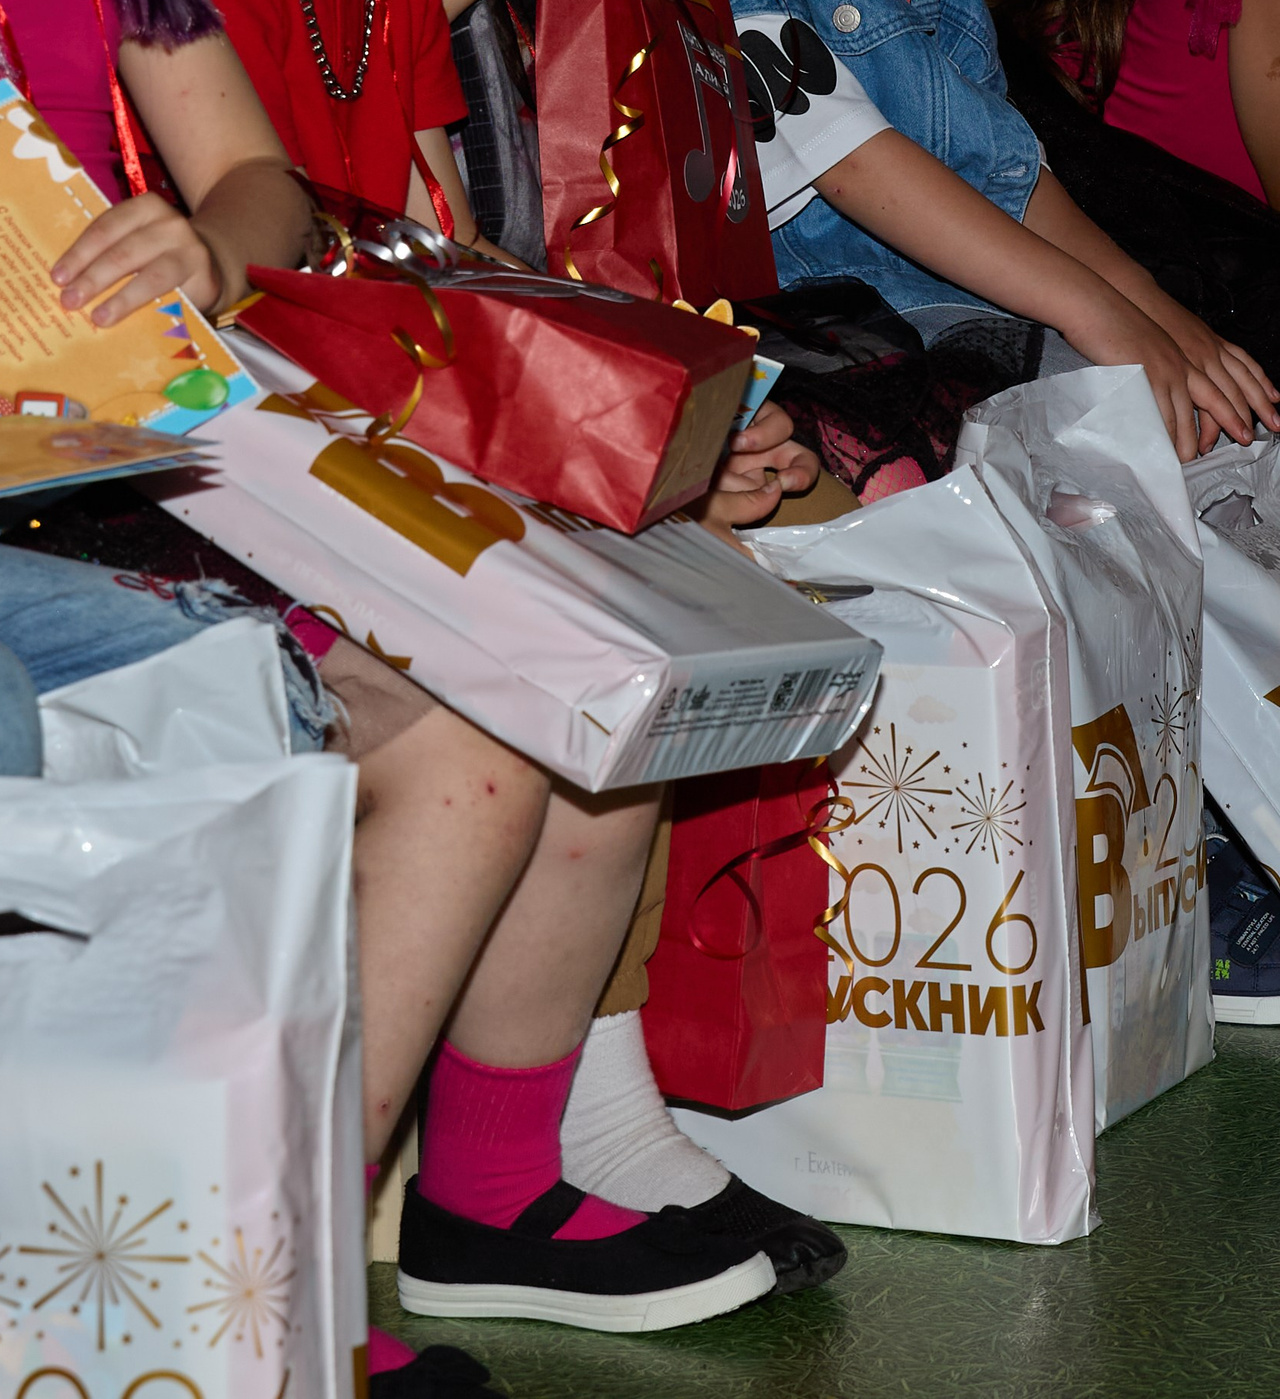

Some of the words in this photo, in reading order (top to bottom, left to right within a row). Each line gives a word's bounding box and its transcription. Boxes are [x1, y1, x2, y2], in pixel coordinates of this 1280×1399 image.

[828, 862, 1038, 976] 026
[1236, 931, 1249, 945] URBAN
[1246, 918, 1258, 931] STYLE
[1241, 930, 1257, 948] CENTRAL
[1254, 911, 1271, 931] LOCATION
